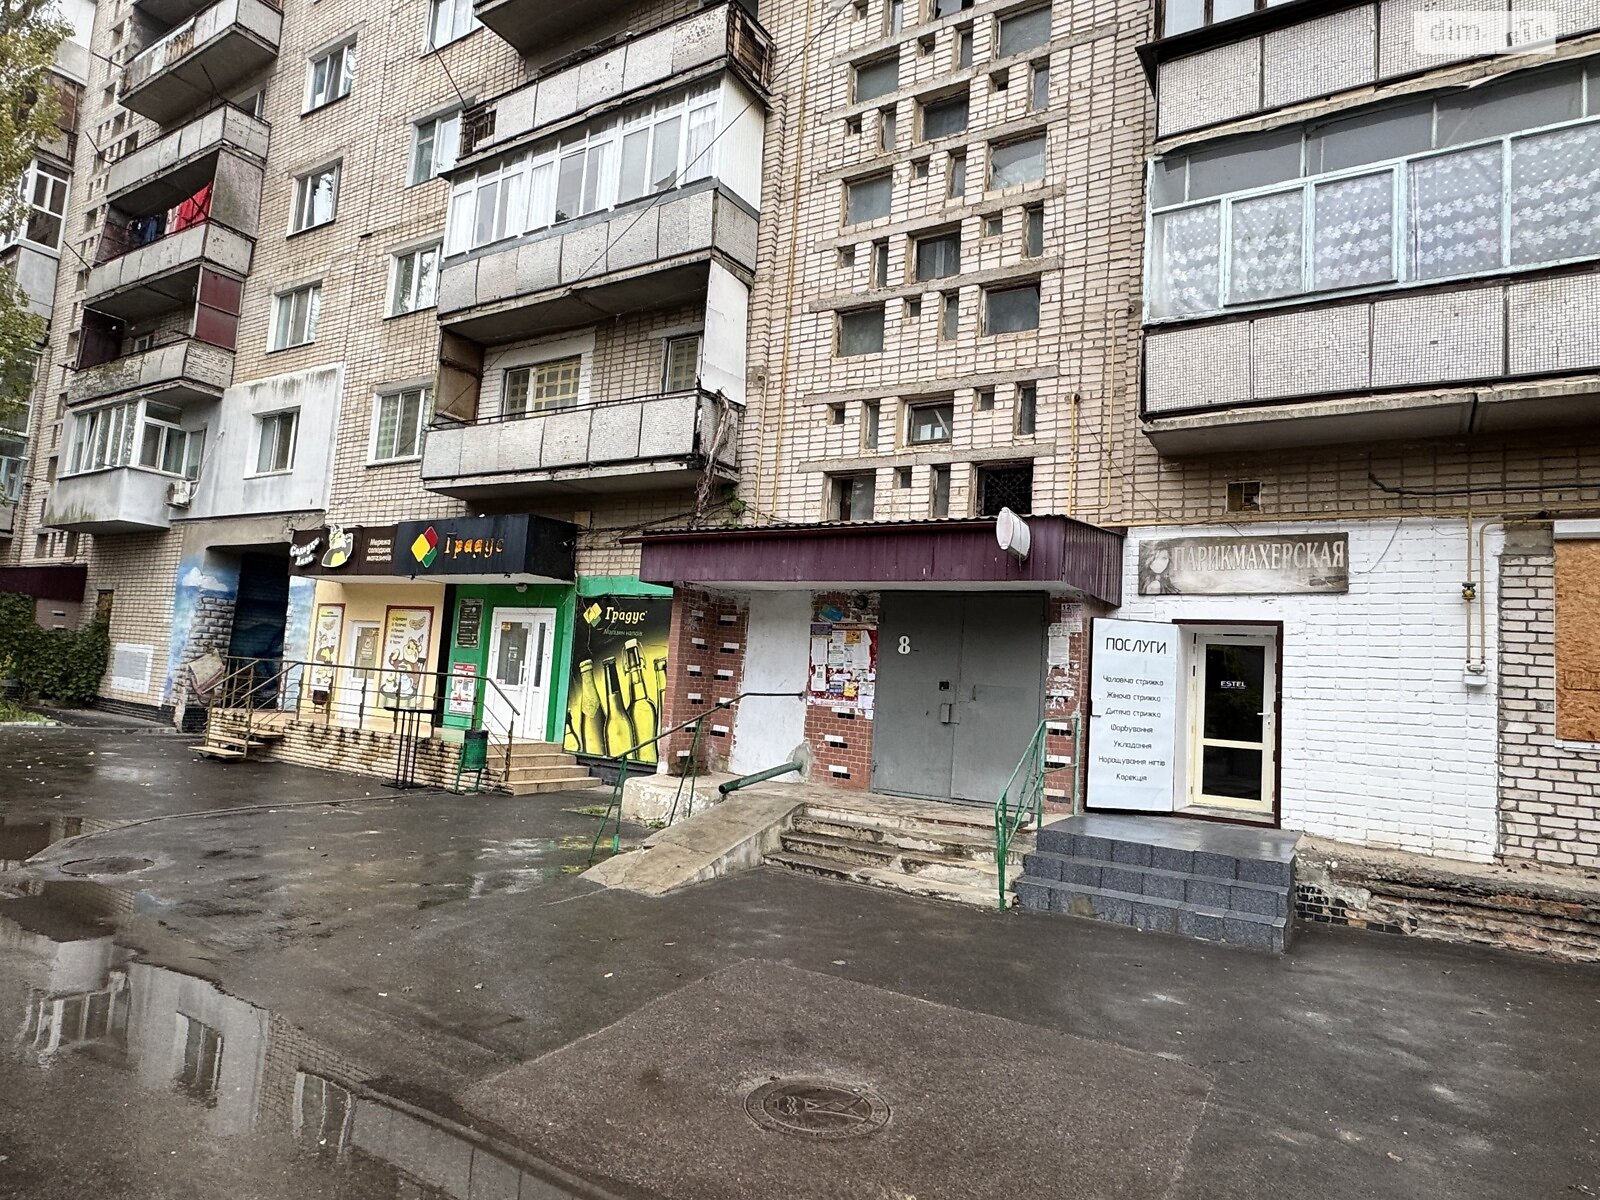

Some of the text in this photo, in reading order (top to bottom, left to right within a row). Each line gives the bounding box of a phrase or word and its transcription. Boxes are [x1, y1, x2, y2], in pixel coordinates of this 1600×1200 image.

[1172, 540, 1346, 571] ПАРИКМАХЕРСКАЯ
[605, 606, 645, 624] Градус
[897, 635, 911, 655] 8
[1106, 637, 1168, 655] ПОСЛУГИ
[1103, 674, 1164, 687] Чоловіча стрижка
[1220, 680, 1246, 688] ESTEL
[1106, 691, 1161, 702] Жіноча стрижка
[1105, 707, 1161, 718] Дитяча стрижка
[1110, 723, 1154, 733] Фарбування
[1113, 740, 1152, 750] Укладання
[1098, 756, 1166, 767] Нарощування нігтів
[1116, 773, 1148, 782] Корекція
